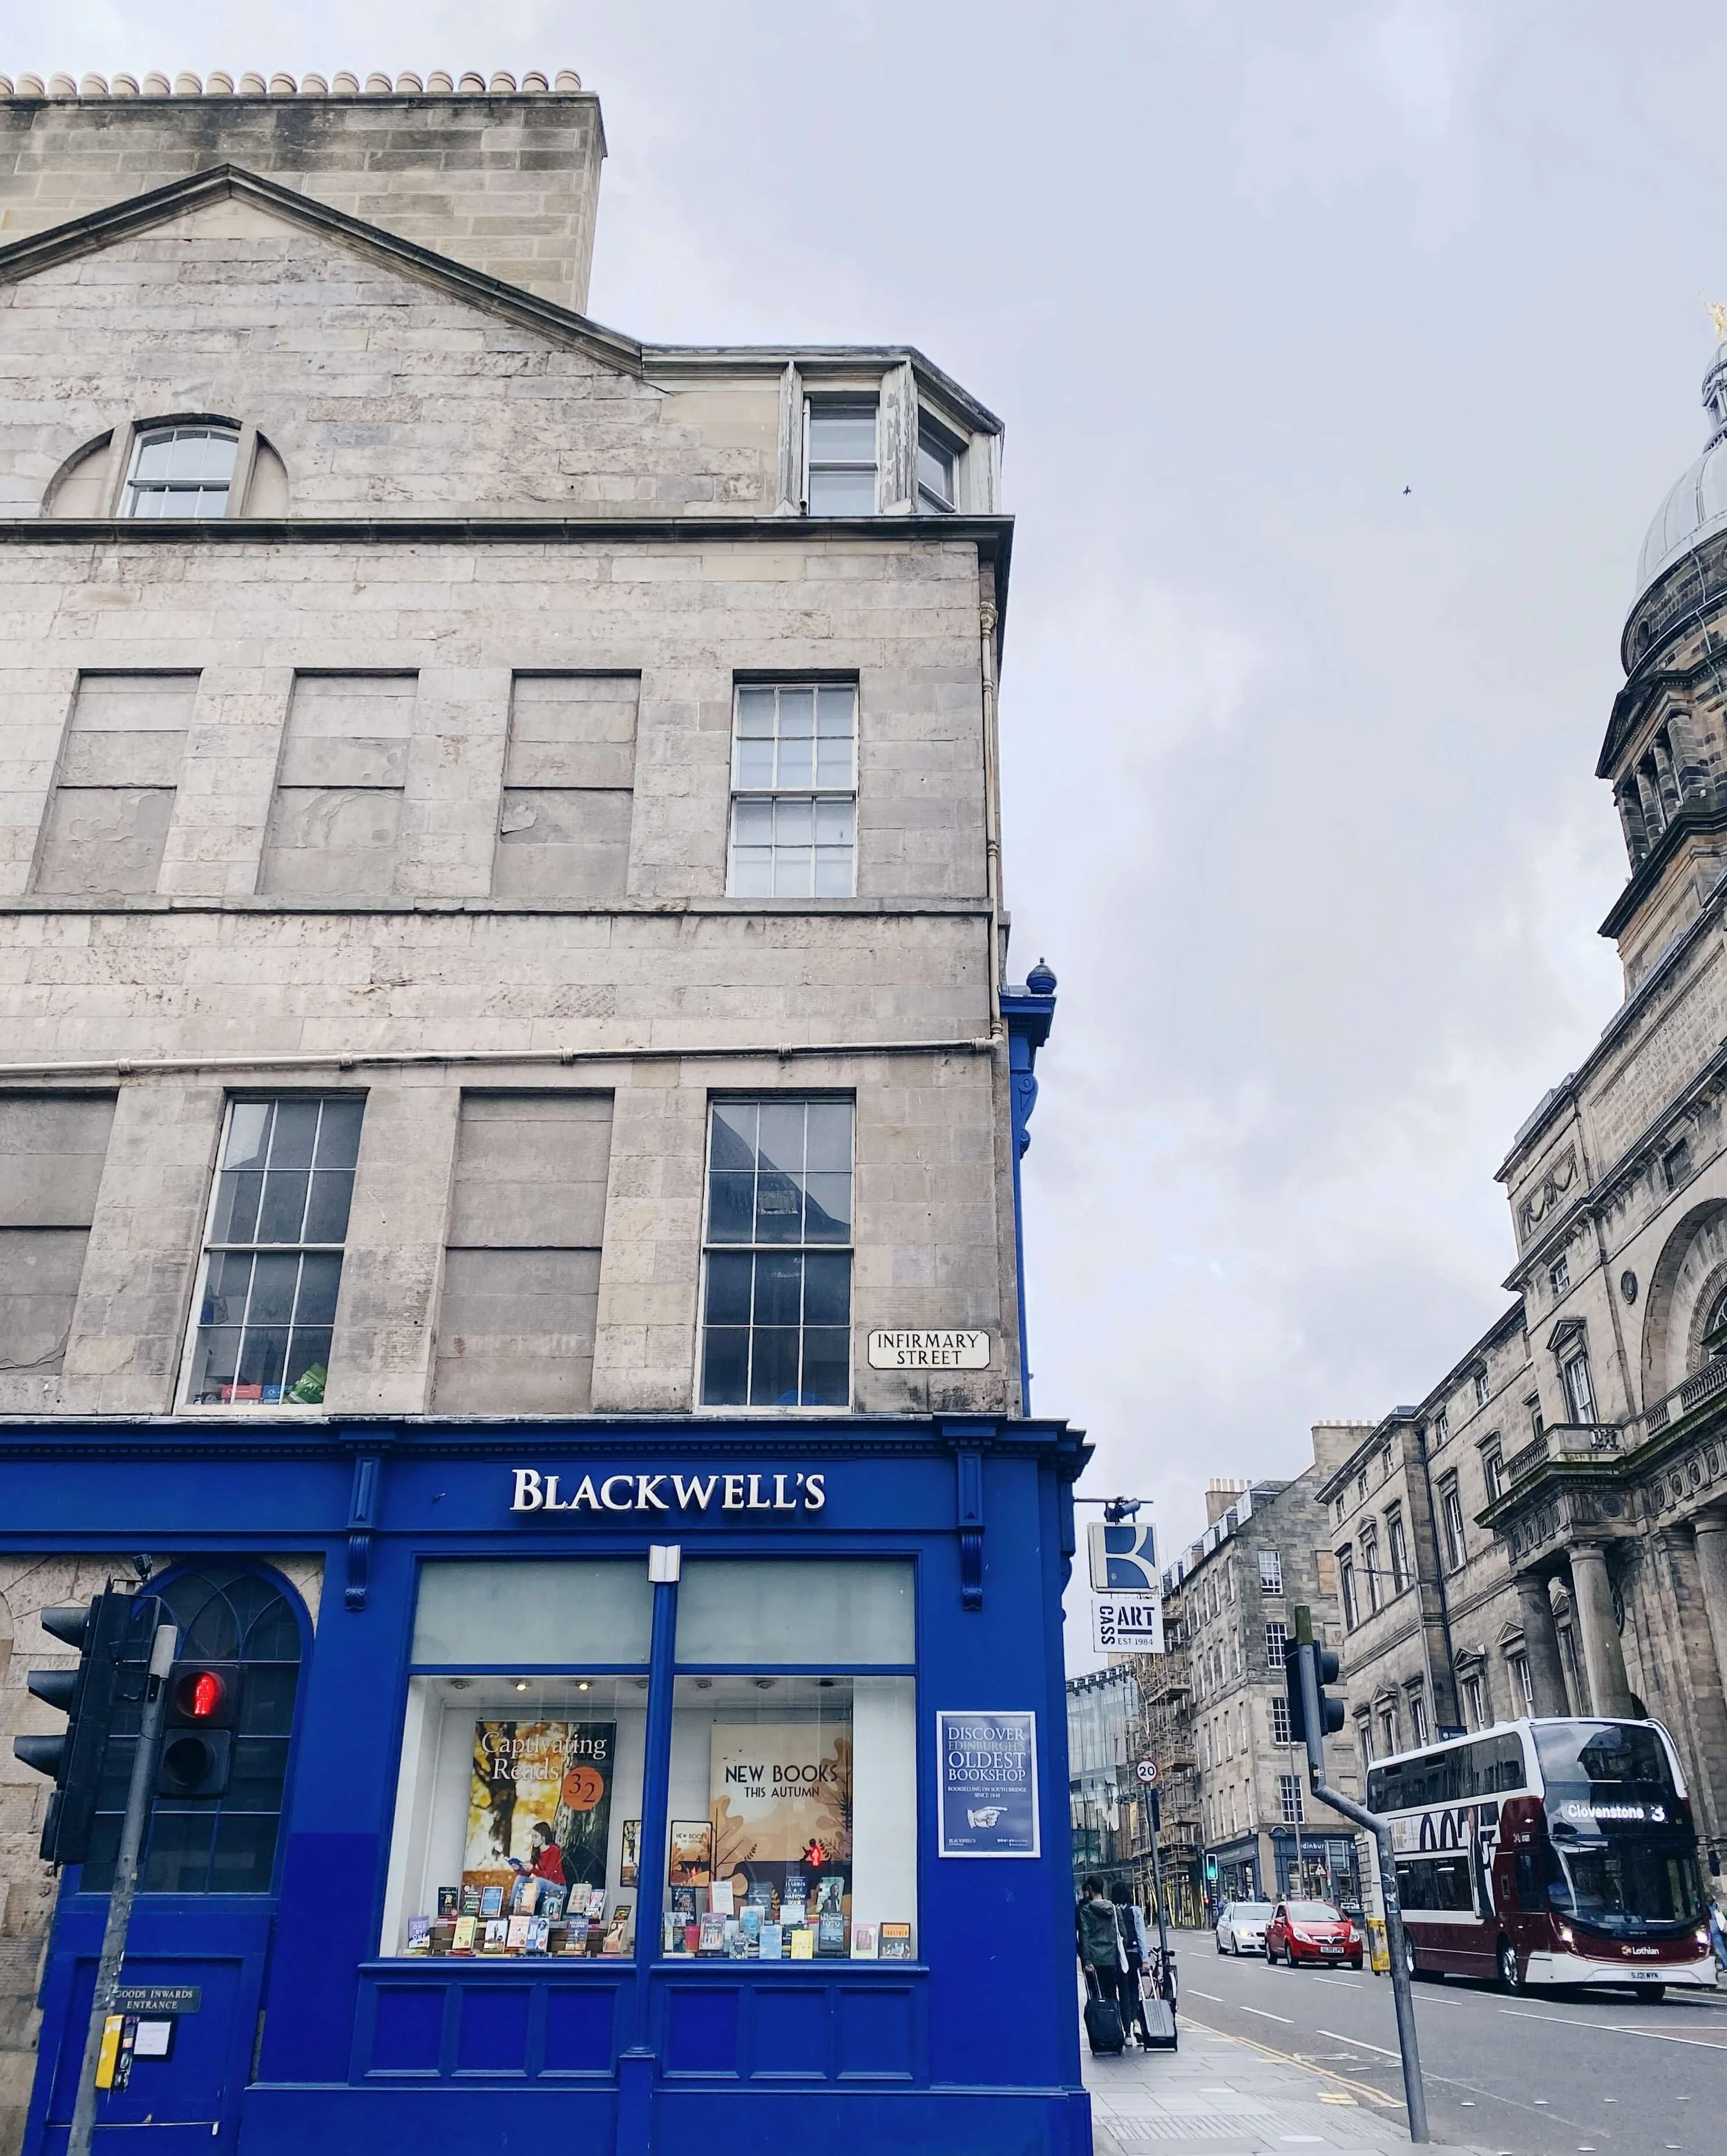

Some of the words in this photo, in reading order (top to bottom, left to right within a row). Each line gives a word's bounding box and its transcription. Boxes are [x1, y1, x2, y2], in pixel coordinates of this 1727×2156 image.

[878, 1333, 979, 1348] INFIRMARY
[897, 1351, 962, 1365] STREET
[1117, 1605, 1155, 1626] ART
[1100, 1605, 1116, 1645] CASS
[1118, 1637, 1132, 1645] EST
[1135, 1637, 1154, 1645] 1984
[947, 1727, 1026, 1741] DISCOVER
[481, 1733, 608, 1759] Captivating
[948, 1751, 1027, 1769] OLDEST
[492, 1758, 560, 1780] Reads
[725, 1766, 765, 1783] NEW
[773, 1765, 839, 1783] BOOKS
[948, 1769, 1027, 1782] BOOKSHOP
[1139, 1766, 1155, 1776] 20
[569, 1773, 581, 1795] 3
[582, 1782, 595, 1803] 2
[744, 1787, 766, 1798] THIS
[771, 1786, 820, 1798] AUTUMN
[1567, 1804, 1645, 1820] Clovenstone
[1632, 1946, 1659, 1955] Lothian
[151, 1990, 193, 1998] INWARDS
[126, 2001, 178, 2010] ENTRANCE
